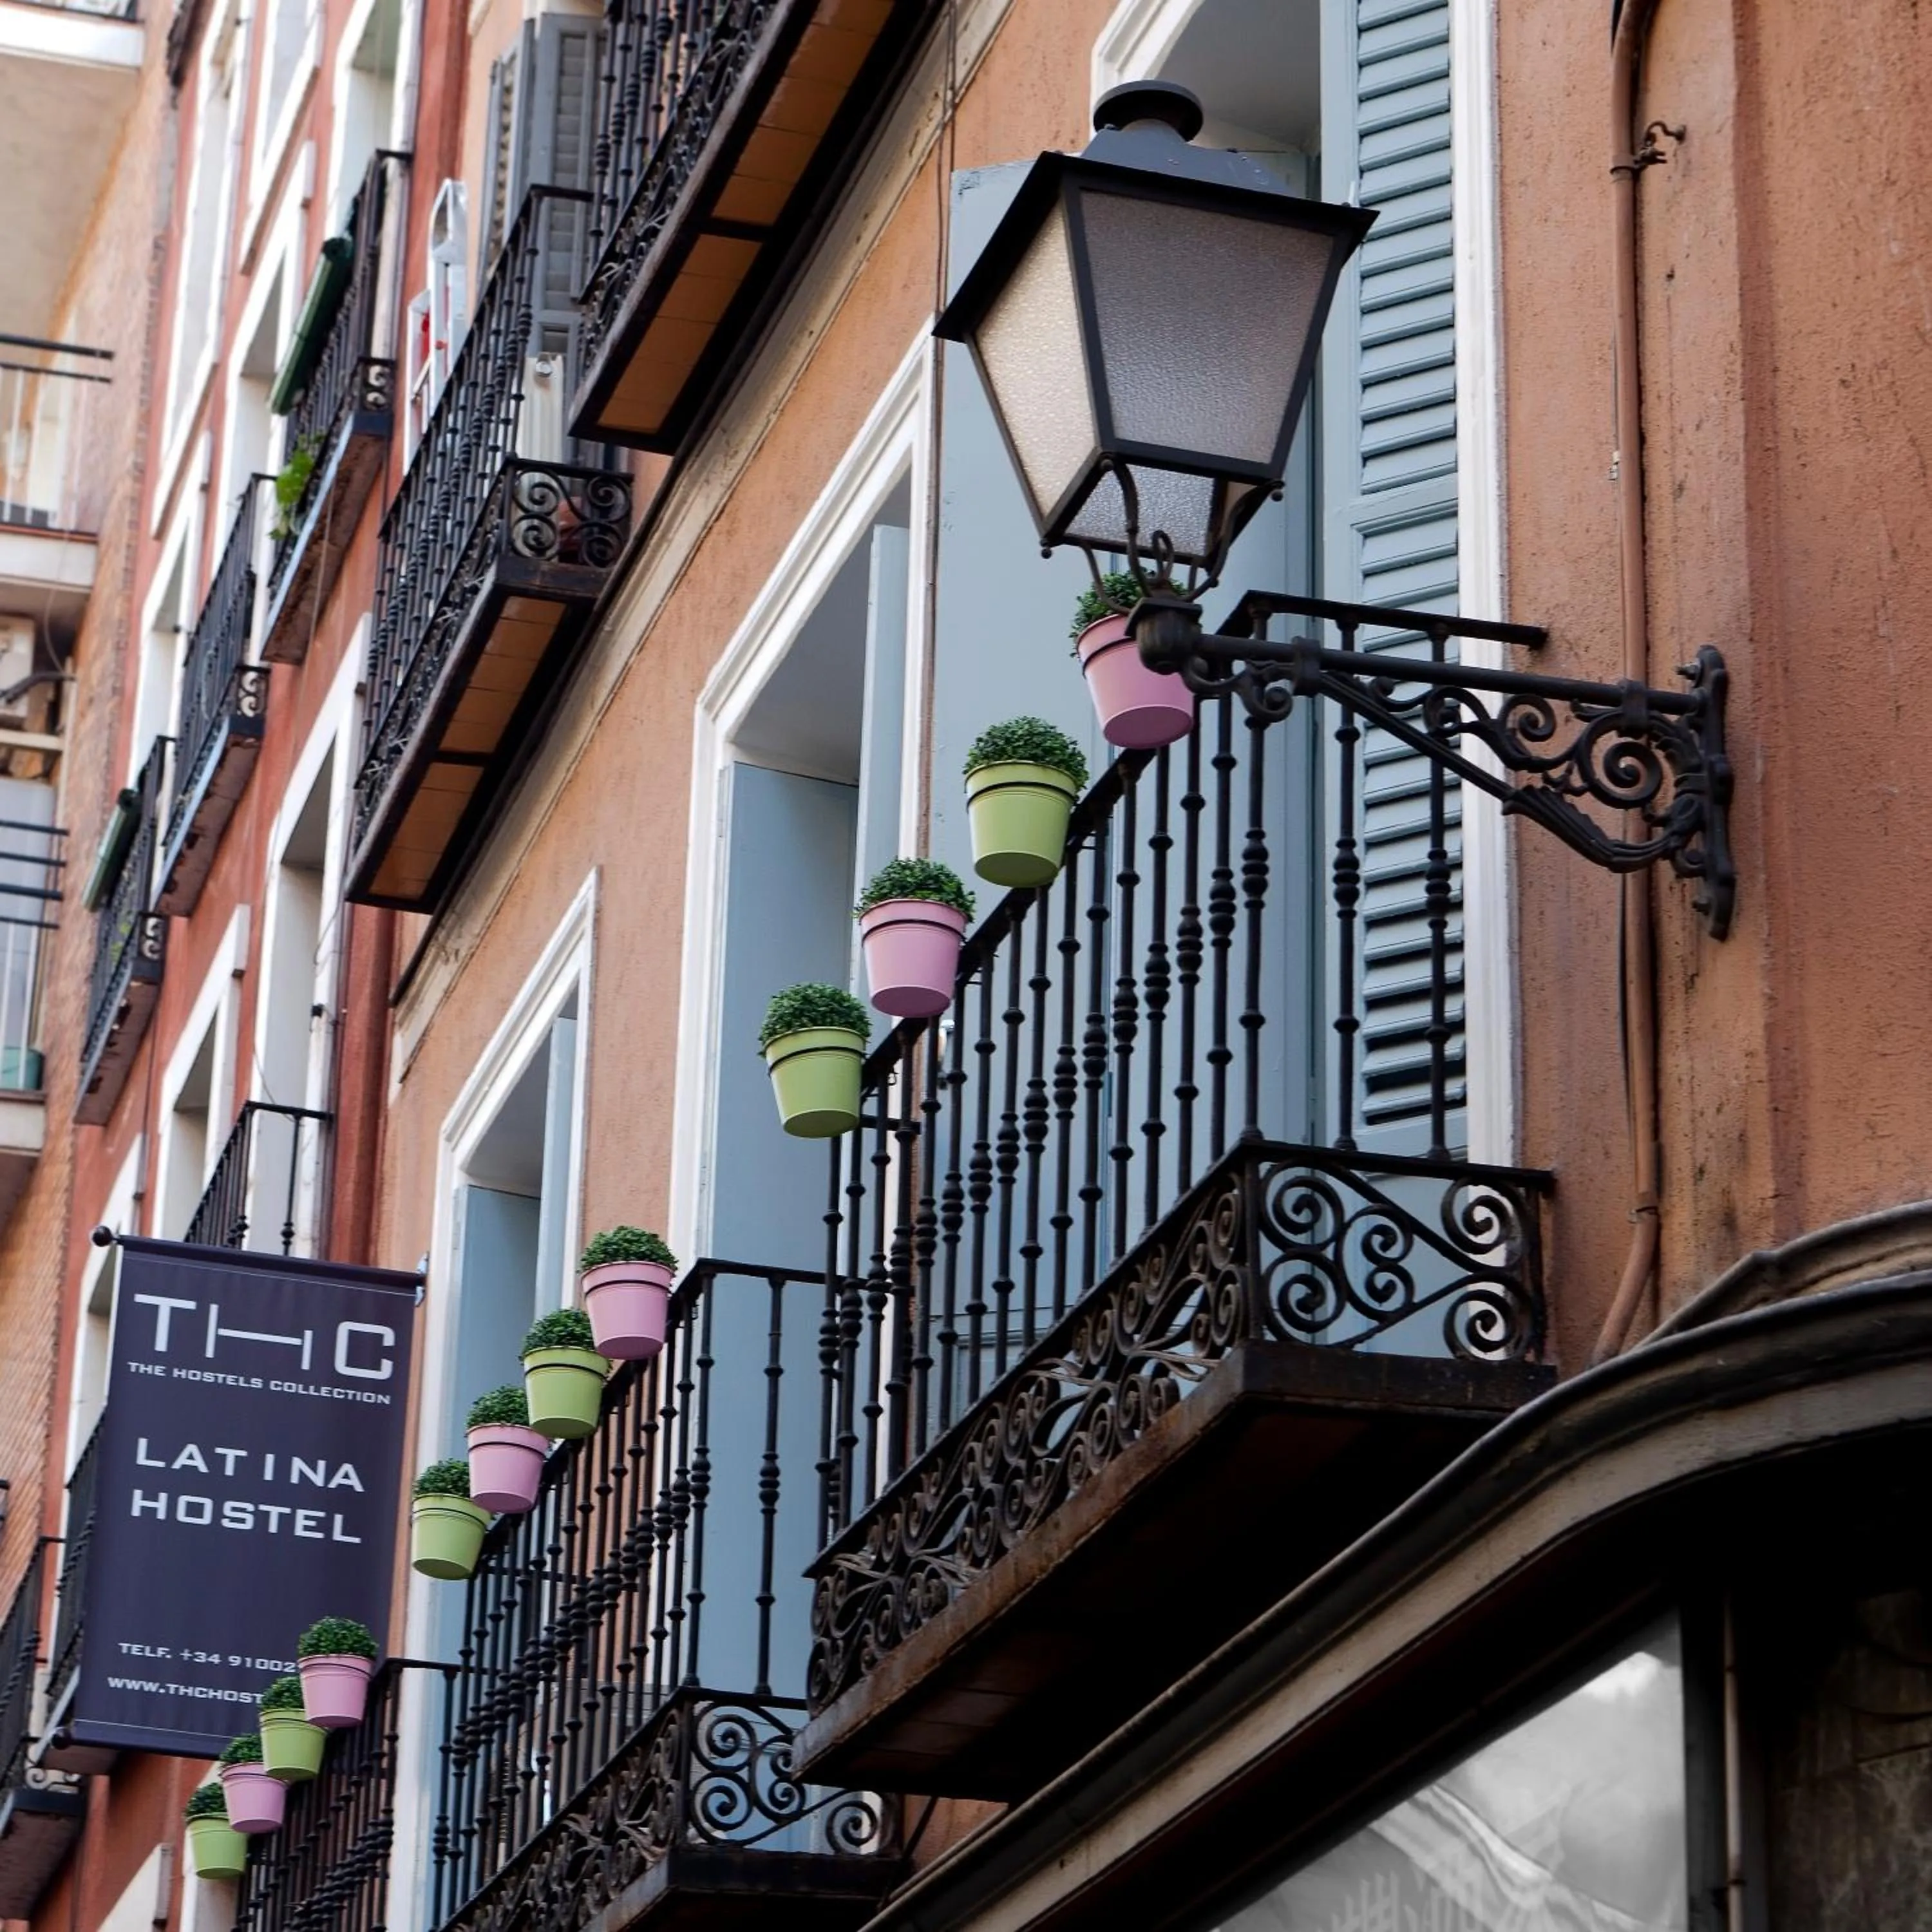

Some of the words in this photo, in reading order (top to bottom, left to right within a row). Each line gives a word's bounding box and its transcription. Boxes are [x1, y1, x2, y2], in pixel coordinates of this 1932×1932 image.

[133, 1293, 395, 1380] THC
[128, 1361, 166, 1376] THE
[173, 1368, 263, 1388] HOSTELS
[269, 1379, 391, 1405] COLLECTION
[136, 1437, 365, 1492] LATINA
[131, 1489, 361, 1544] HOSTEL
[118, 1643, 172, 1658] TELF.
[180, 1649, 222, 1664] +34
